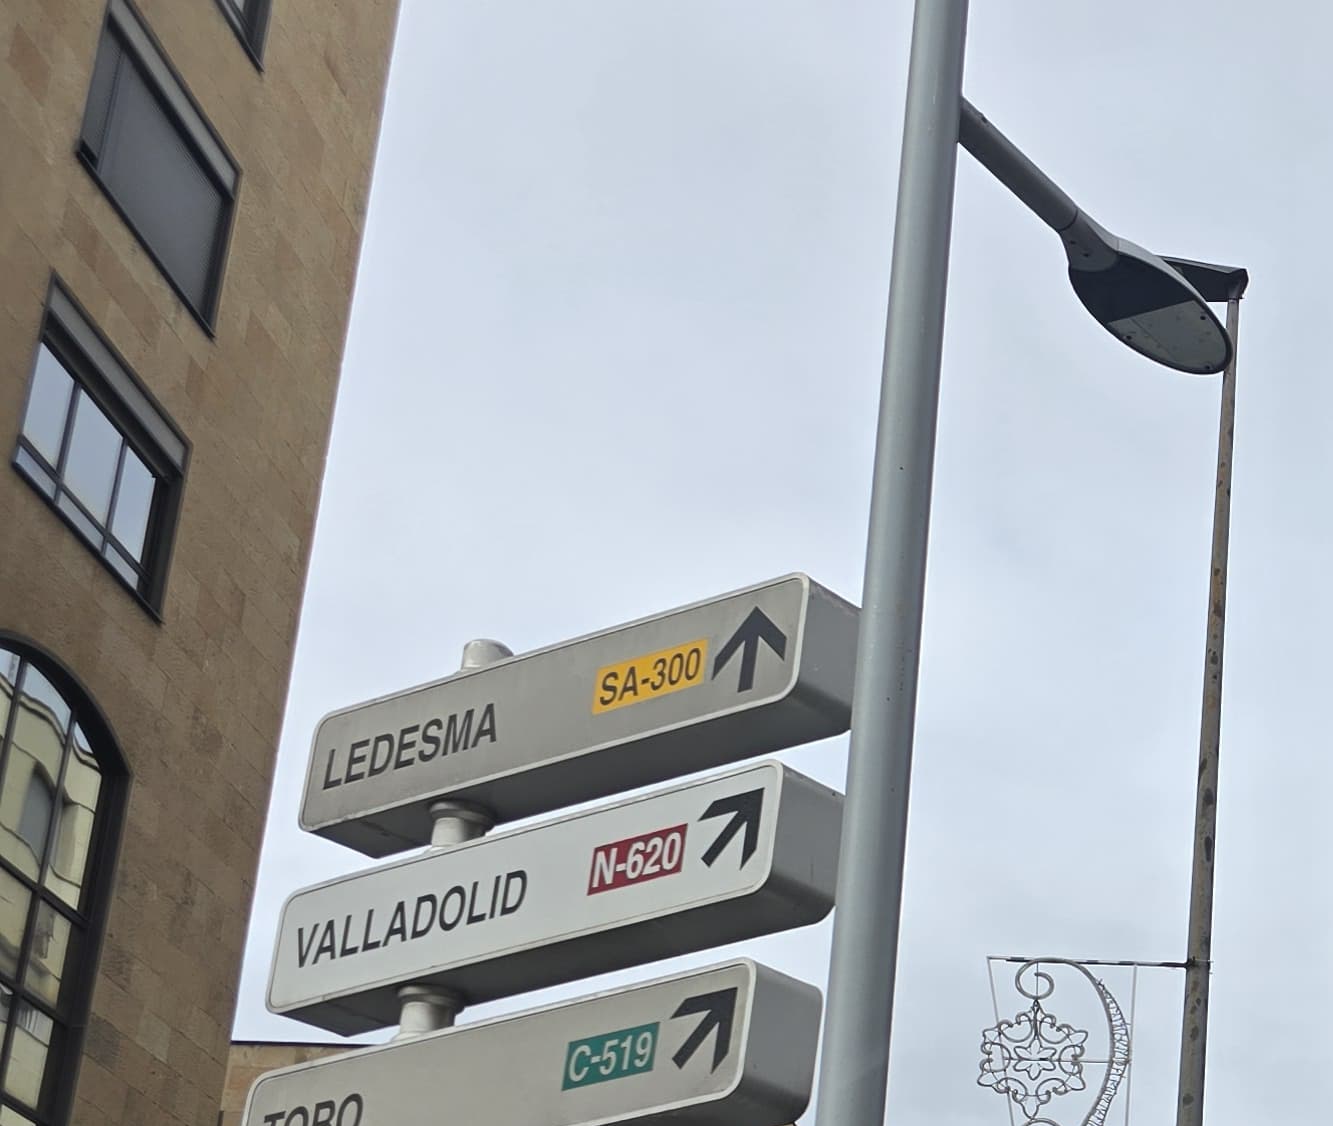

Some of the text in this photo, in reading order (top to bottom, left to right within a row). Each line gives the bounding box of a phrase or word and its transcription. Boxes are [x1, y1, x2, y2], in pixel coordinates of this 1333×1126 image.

[323, 646, 702, 790] LEDESMA SA-300
[296, 830, 683, 968] VALLADOLID N-620
[568, 1030, 655, 1082] C-519
